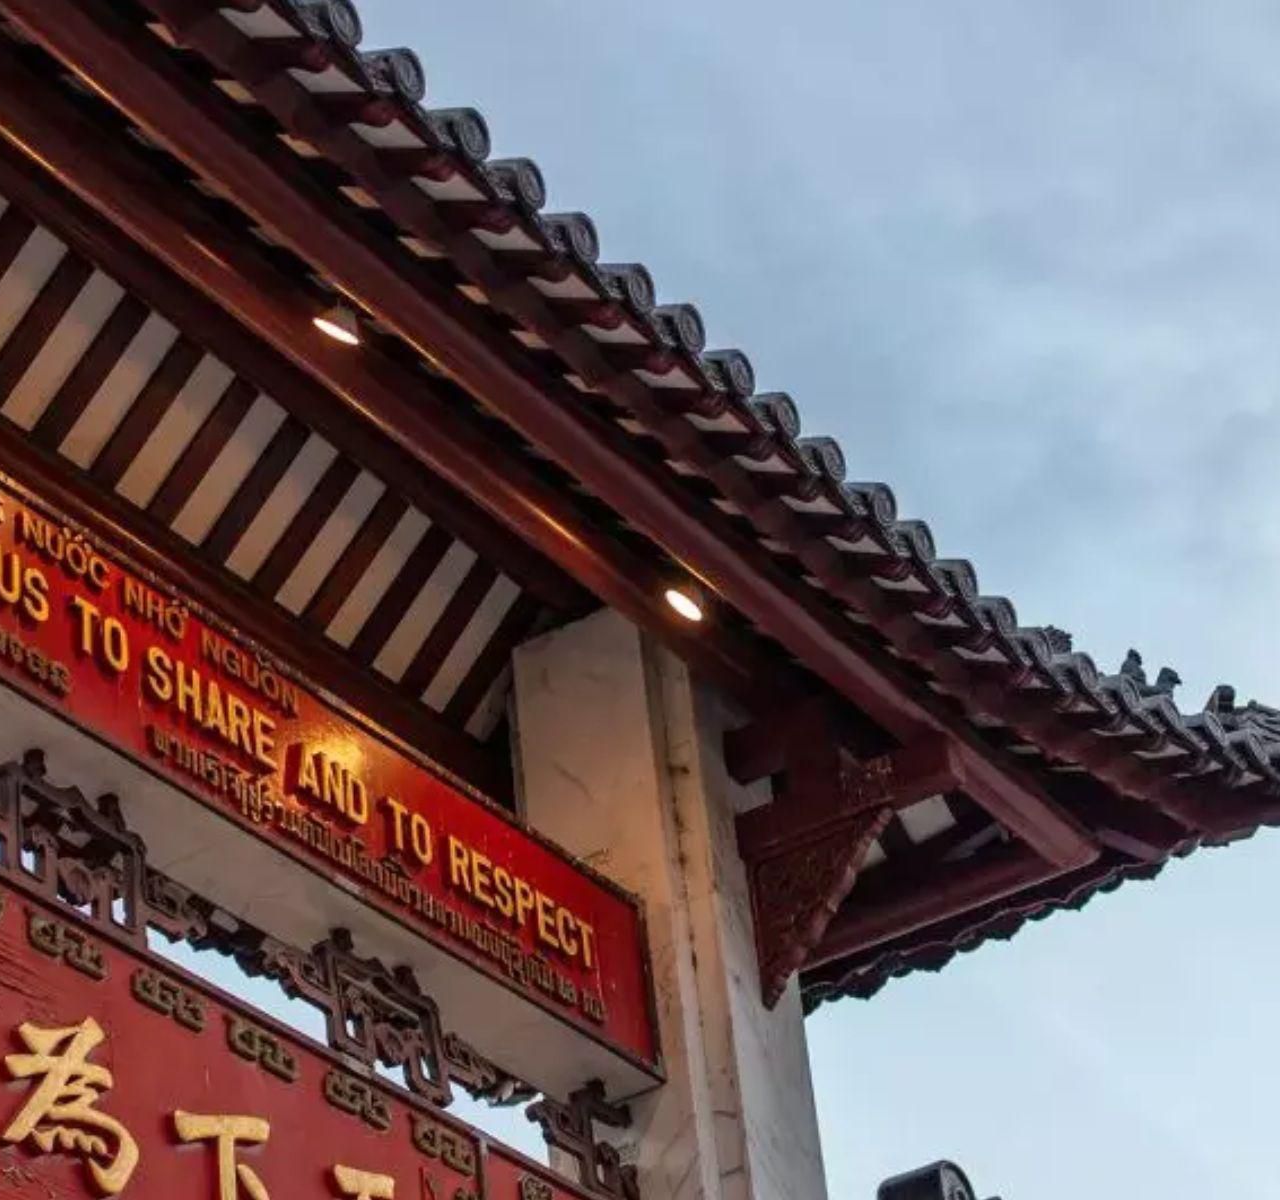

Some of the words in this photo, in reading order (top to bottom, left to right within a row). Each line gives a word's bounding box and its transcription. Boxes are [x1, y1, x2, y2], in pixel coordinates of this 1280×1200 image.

[75, 596, 129, 672] TO
[147, 646, 277, 769] SHARE
[298, 750, 368, 825] AND
[388, 798, 432, 864] TO
[449, 835, 595, 968] RESPECT
